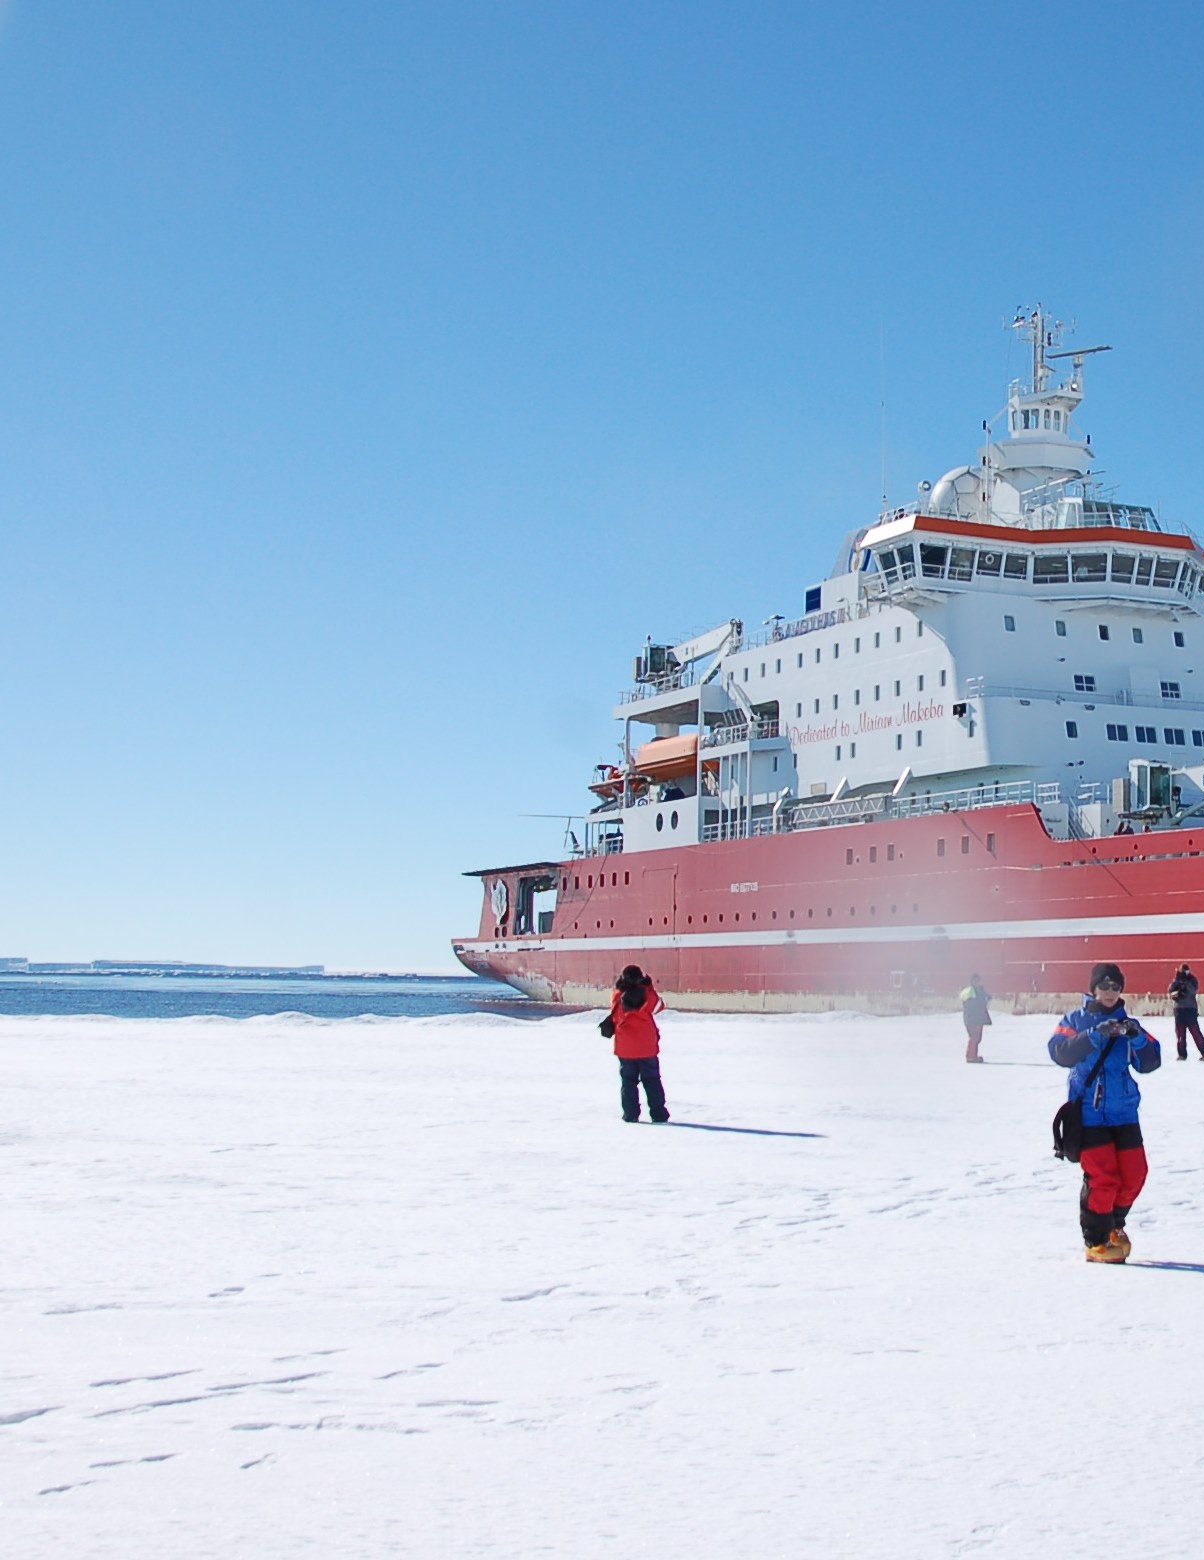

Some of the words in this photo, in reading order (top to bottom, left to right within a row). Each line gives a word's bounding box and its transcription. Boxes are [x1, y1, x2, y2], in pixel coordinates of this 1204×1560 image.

[789, 719, 837, 746] Dedicated
[840, 721, 850, 737] to
[853, 711, 893, 735] Miriam
[897, 698, 944, 727] Makeba
